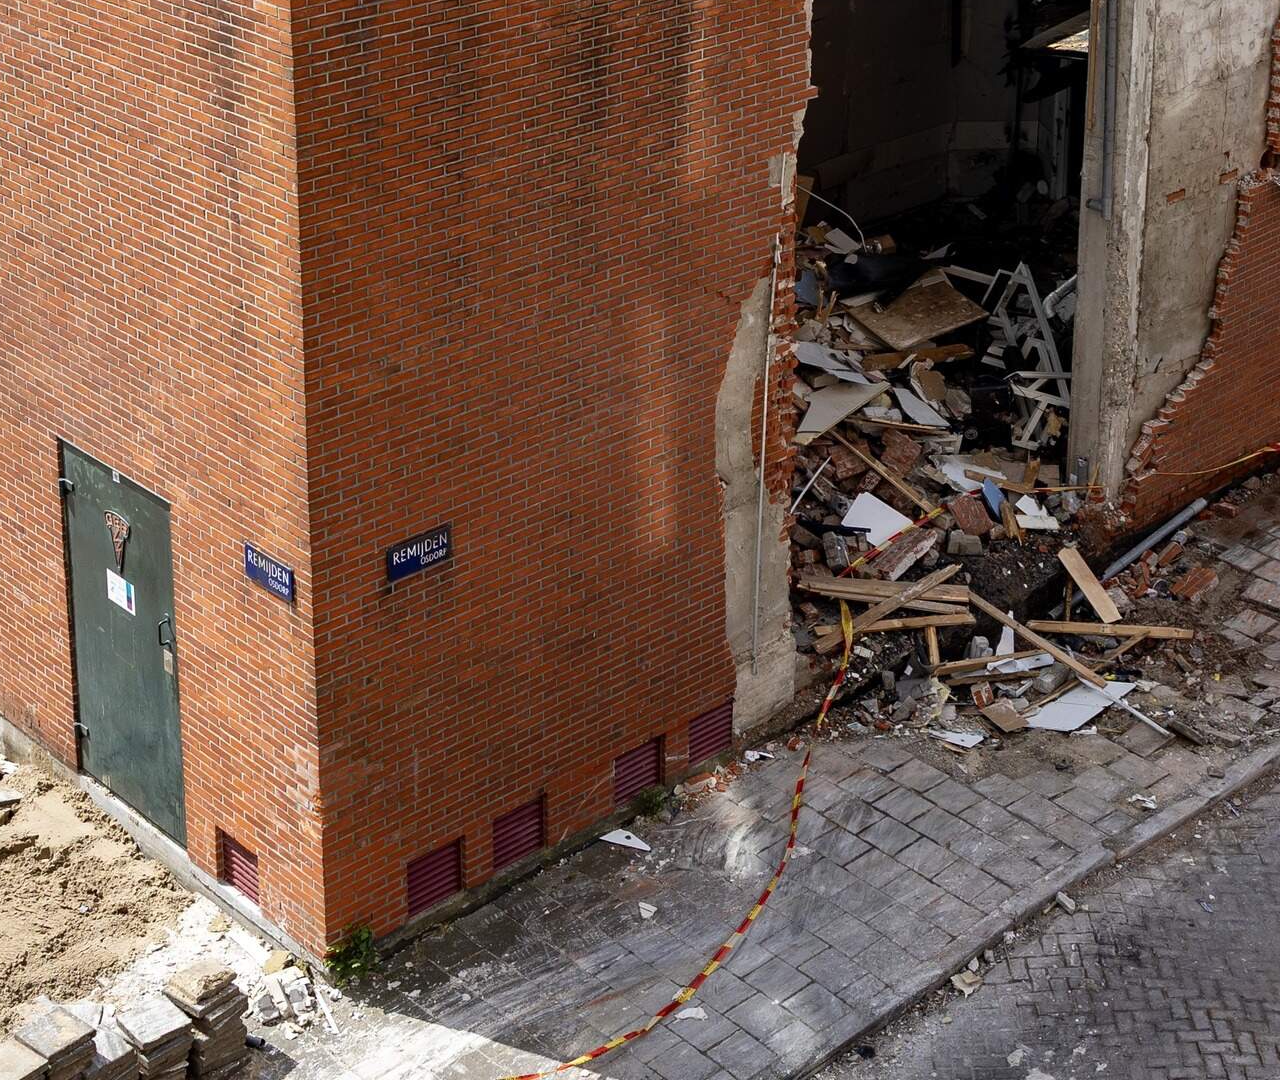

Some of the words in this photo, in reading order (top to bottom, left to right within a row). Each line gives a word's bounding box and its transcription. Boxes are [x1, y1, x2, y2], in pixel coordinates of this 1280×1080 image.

[392, 532, 448, 565] REMIJDEN
[420, 548, 448, 565] OSDORP
[247, 549, 290, 584] REMIJDEN
[268, 577, 290, 595] OSDORP
